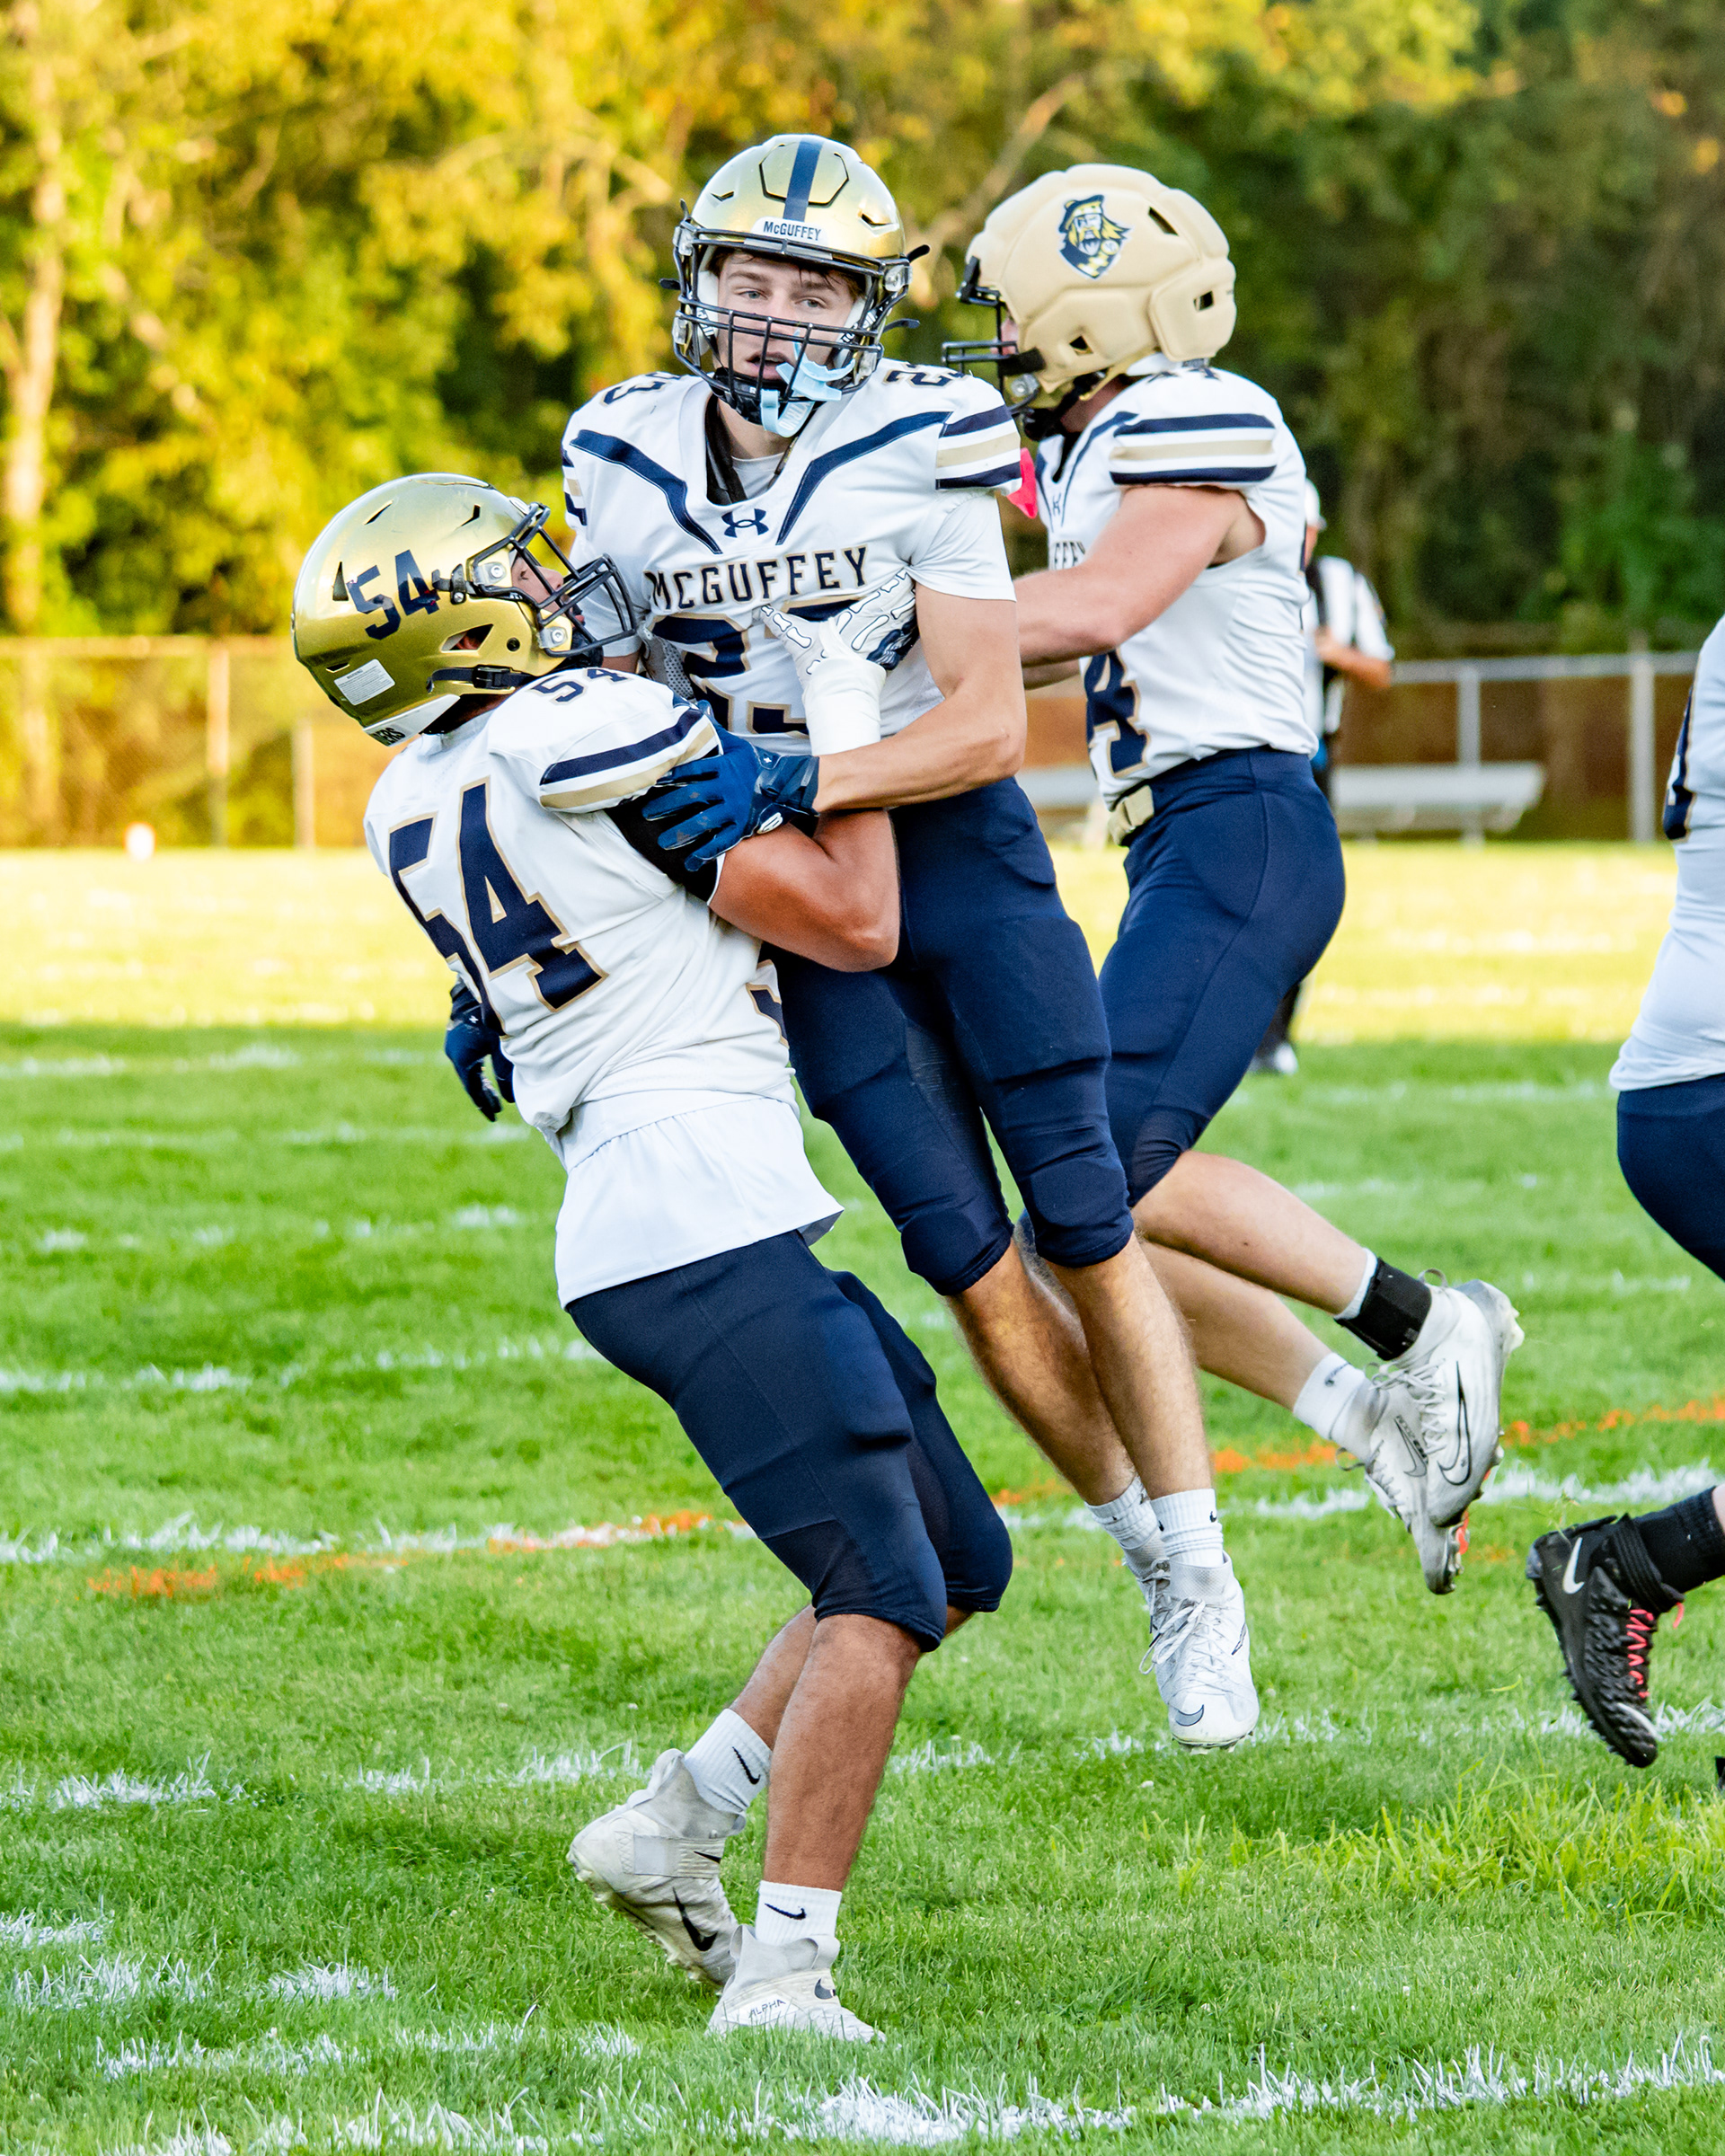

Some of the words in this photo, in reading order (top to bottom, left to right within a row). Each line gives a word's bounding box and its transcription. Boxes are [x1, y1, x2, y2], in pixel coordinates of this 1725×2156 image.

[762, 220, 822, 242] McGUFFEY
[346, 549, 441, 641] 54
[643, 544, 868, 611] MCGUFFEY
[525, 667, 634, 706] 54
[387, 774, 610, 1042] 54
[748, 1999, 787, 2019] ALPHA
